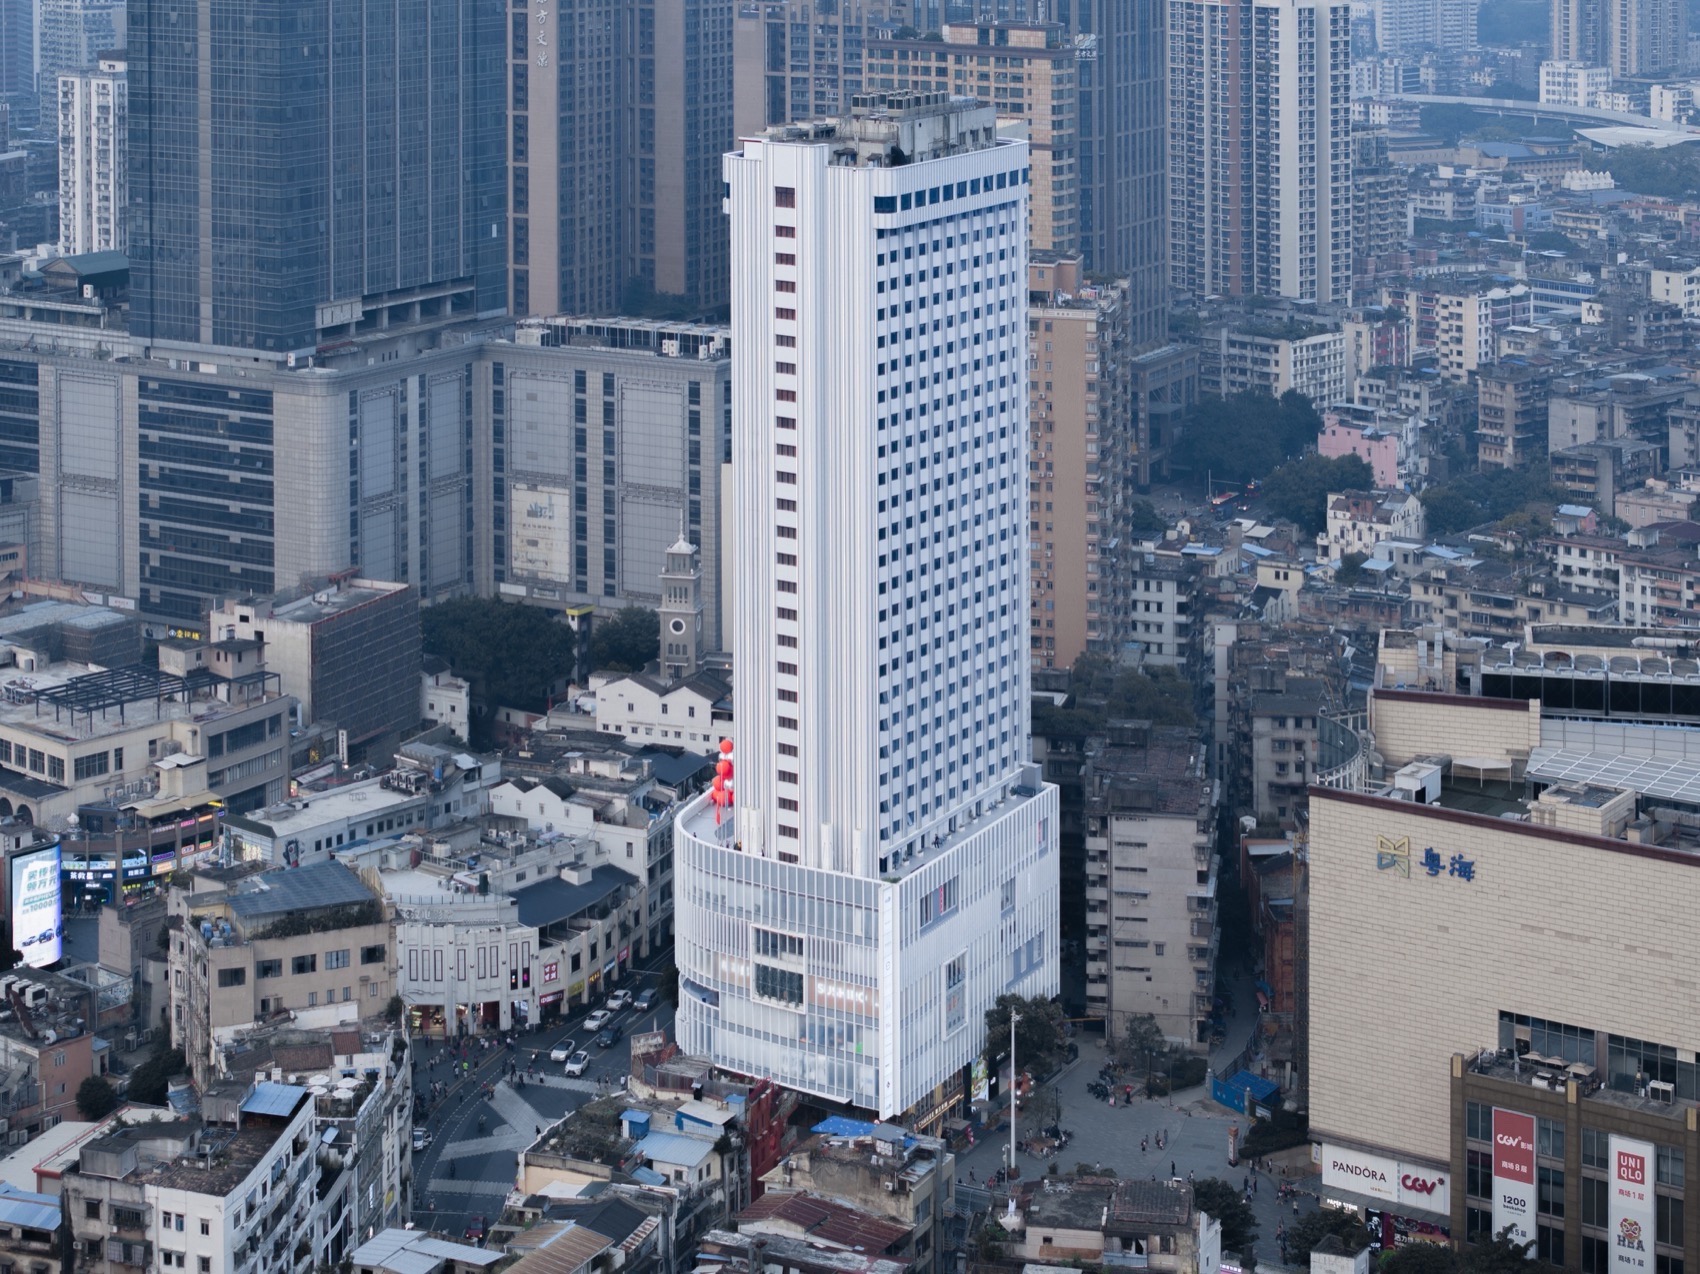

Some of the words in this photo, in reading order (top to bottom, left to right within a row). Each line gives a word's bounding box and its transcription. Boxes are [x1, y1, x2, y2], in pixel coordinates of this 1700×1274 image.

[1419, 847, 1475, 882] 粤海
[1496, 1133, 1519, 1147] CGV
[1620, 1155, 1640, 1169] UNI
[1332, 1160, 1387, 1183] PANDORA
[1620, 1167, 1642, 1181] QLO
[1401, 1173, 1437, 1196] CGV
[1502, 1194, 1526, 1208] 1200
[1617, 1234, 1645, 1253] HEA
